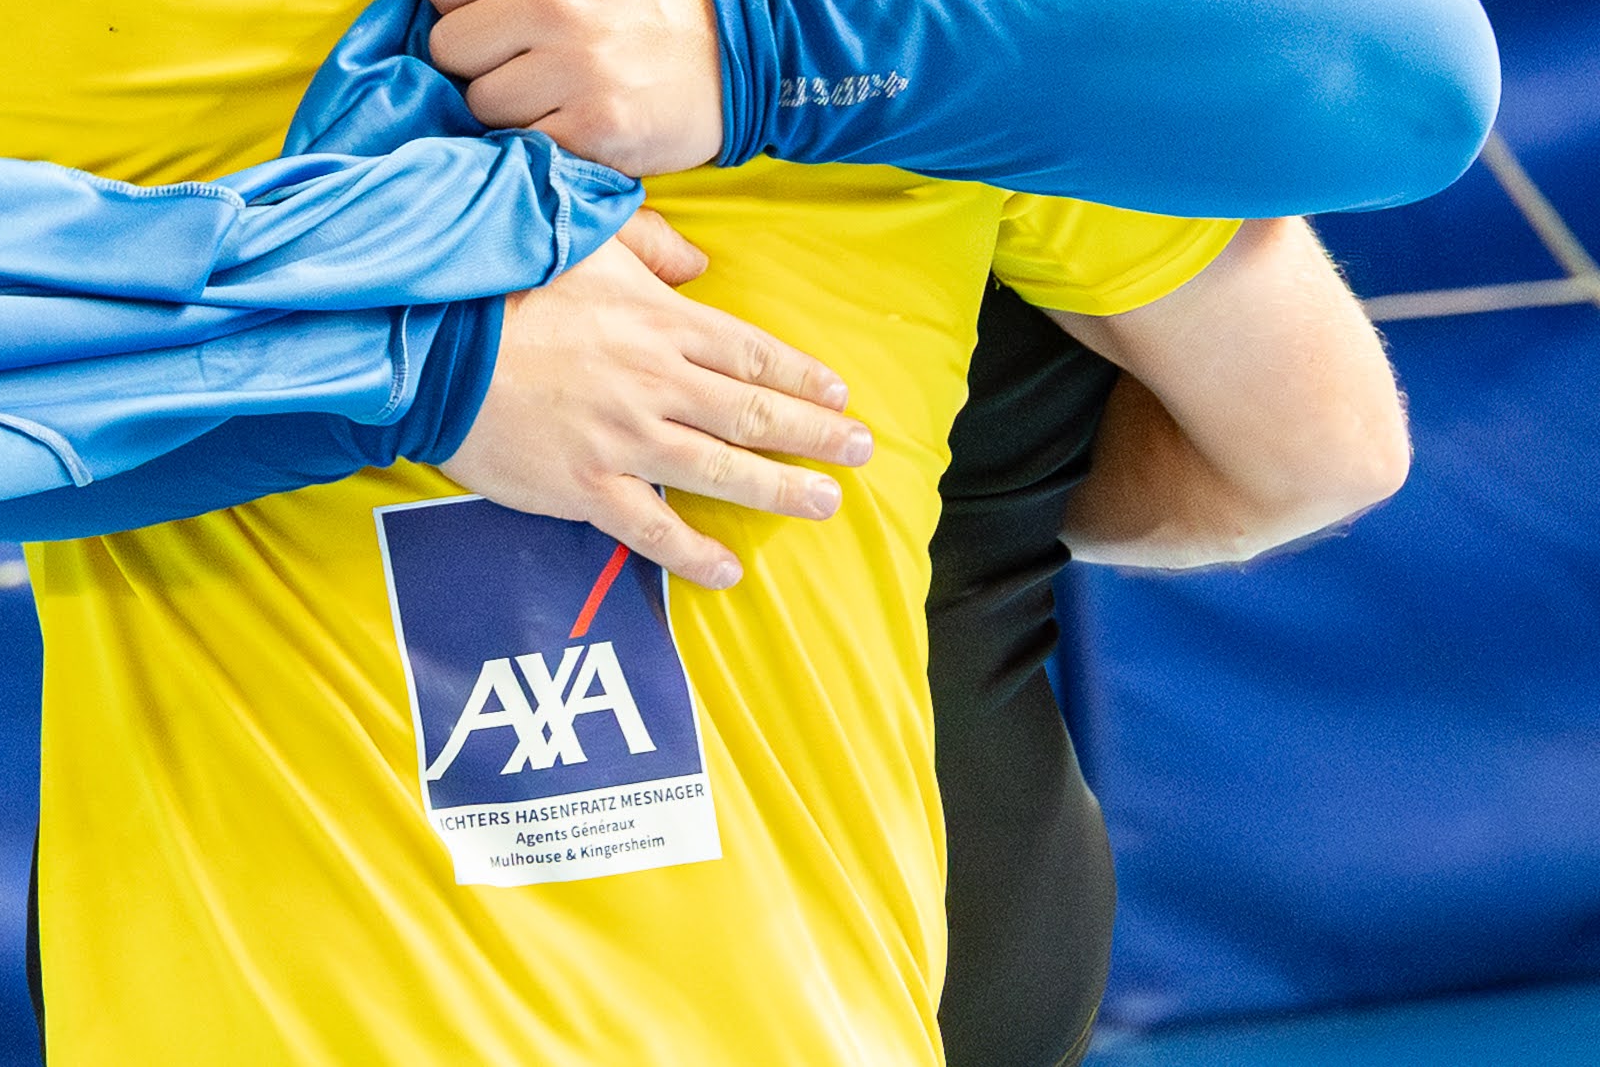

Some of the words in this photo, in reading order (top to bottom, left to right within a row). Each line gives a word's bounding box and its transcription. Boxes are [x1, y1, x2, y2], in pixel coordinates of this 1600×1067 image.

[426, 641, 657, 781] AXA
[515, 796, 617, 825] HASENFRATZ
[620, 783, 705, 808] MESNAGER
[489, 850, 562, 868] Mulhouse
[565, 848, 577, 862] &
[580, 834, 665, 860] Kingersheim
[515, 829, 568, 847] Agents
[570, 818, 636, 839] Généraux
